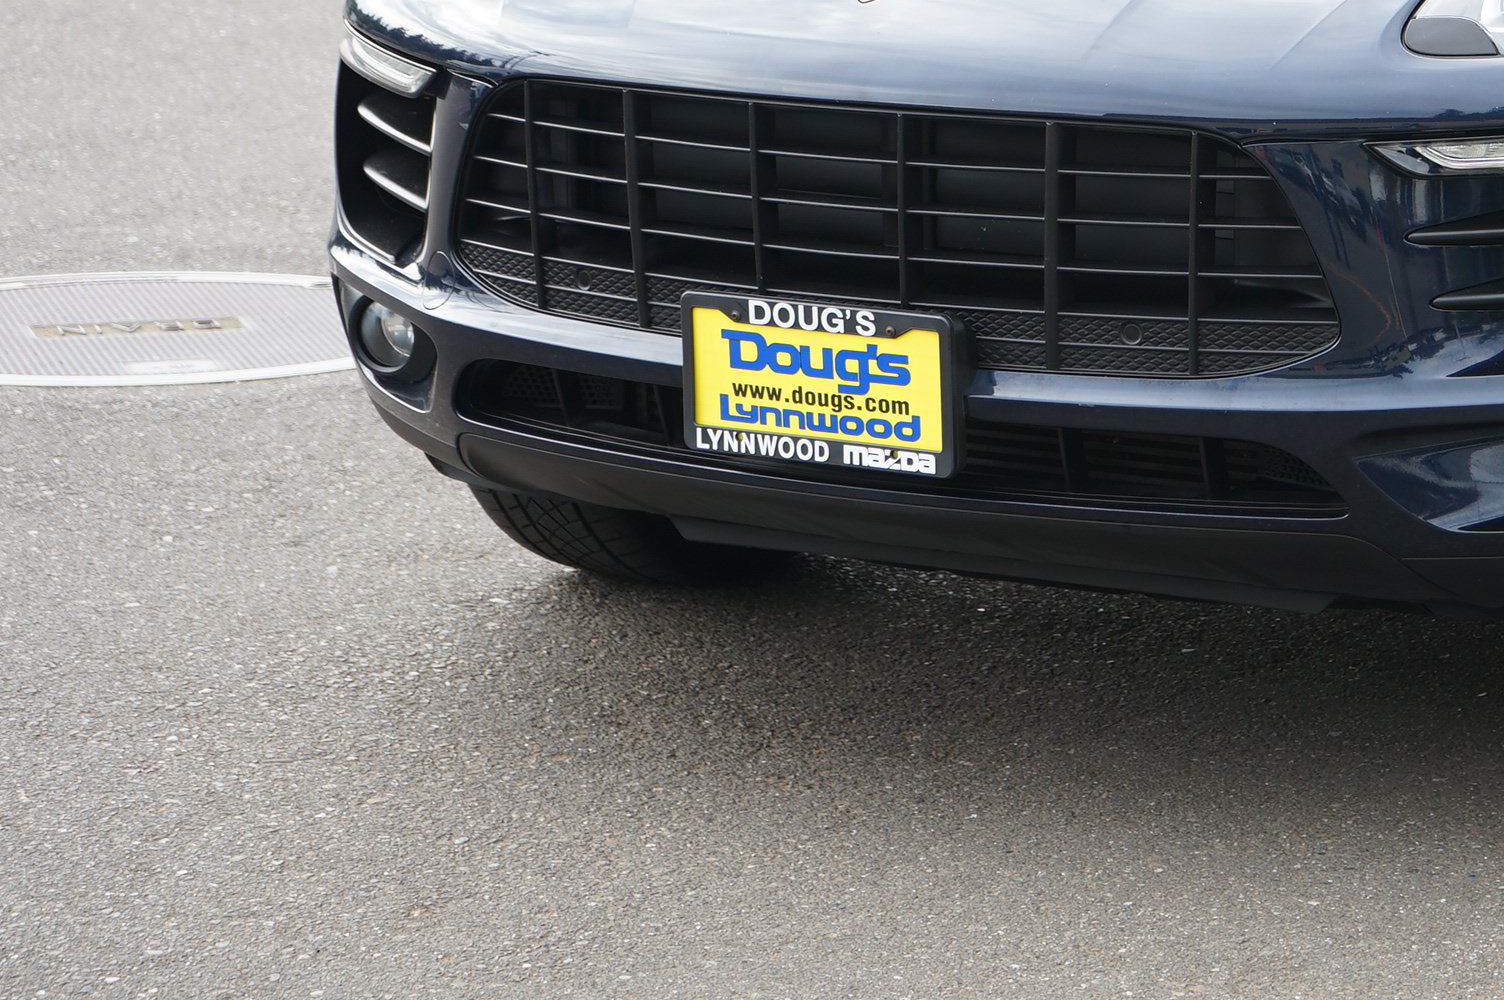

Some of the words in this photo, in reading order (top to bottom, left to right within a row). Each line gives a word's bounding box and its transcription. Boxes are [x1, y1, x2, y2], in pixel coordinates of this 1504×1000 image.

[748, 300, 876, 337] DOUG'S
[721, 328, 911, 395] Doug's
[732, 382, 910, 415] www.dougs.com
[720, 394, 921, 442] Lynnwood
[696, 427, 830, 462] LYNNWOOD
